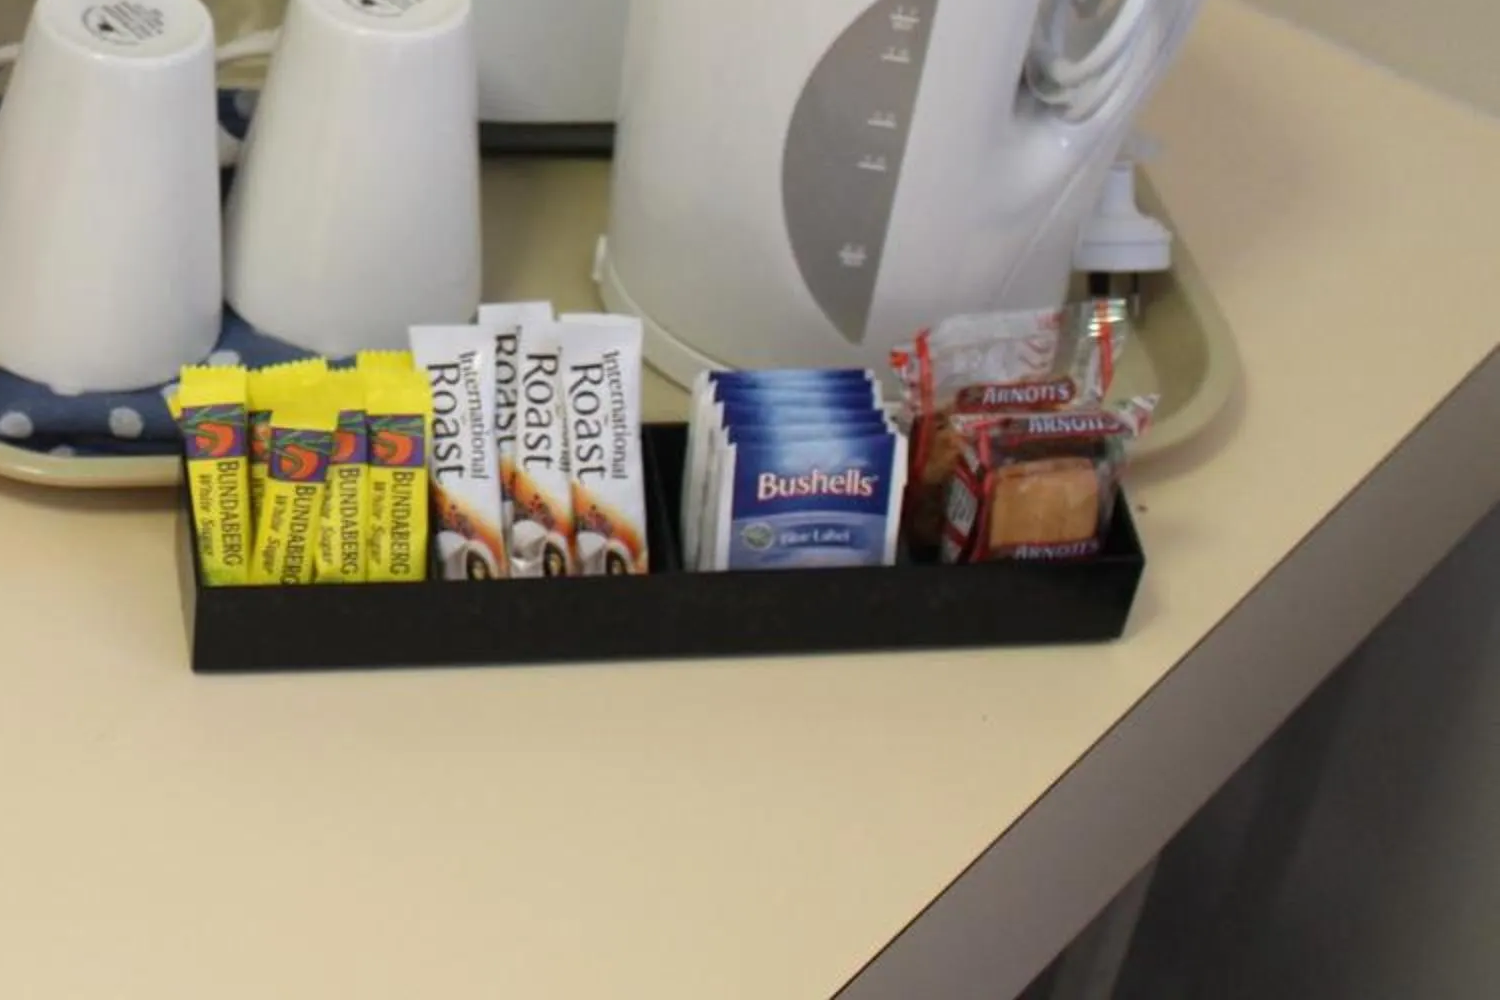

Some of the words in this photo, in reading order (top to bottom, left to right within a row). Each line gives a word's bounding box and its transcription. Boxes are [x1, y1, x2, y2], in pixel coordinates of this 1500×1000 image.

[426, 362, 466, 485] Roast
[459, 350, 492, 480] International
[522, 353, 554, 474] Roast
[568, 362, 607, 486] Roast
[602, 349, 631, 480] International
[216, 461, 243, 567] BUNDABERG
[280, 485, 317, 585] BUNDABERG
[338, 468, 361, 576] BUNDABERG
[389, 471, 415, 576] BUNDABERG
[757, 468, 874, 501] Bushells
[812, 527, 852, 543] Label
